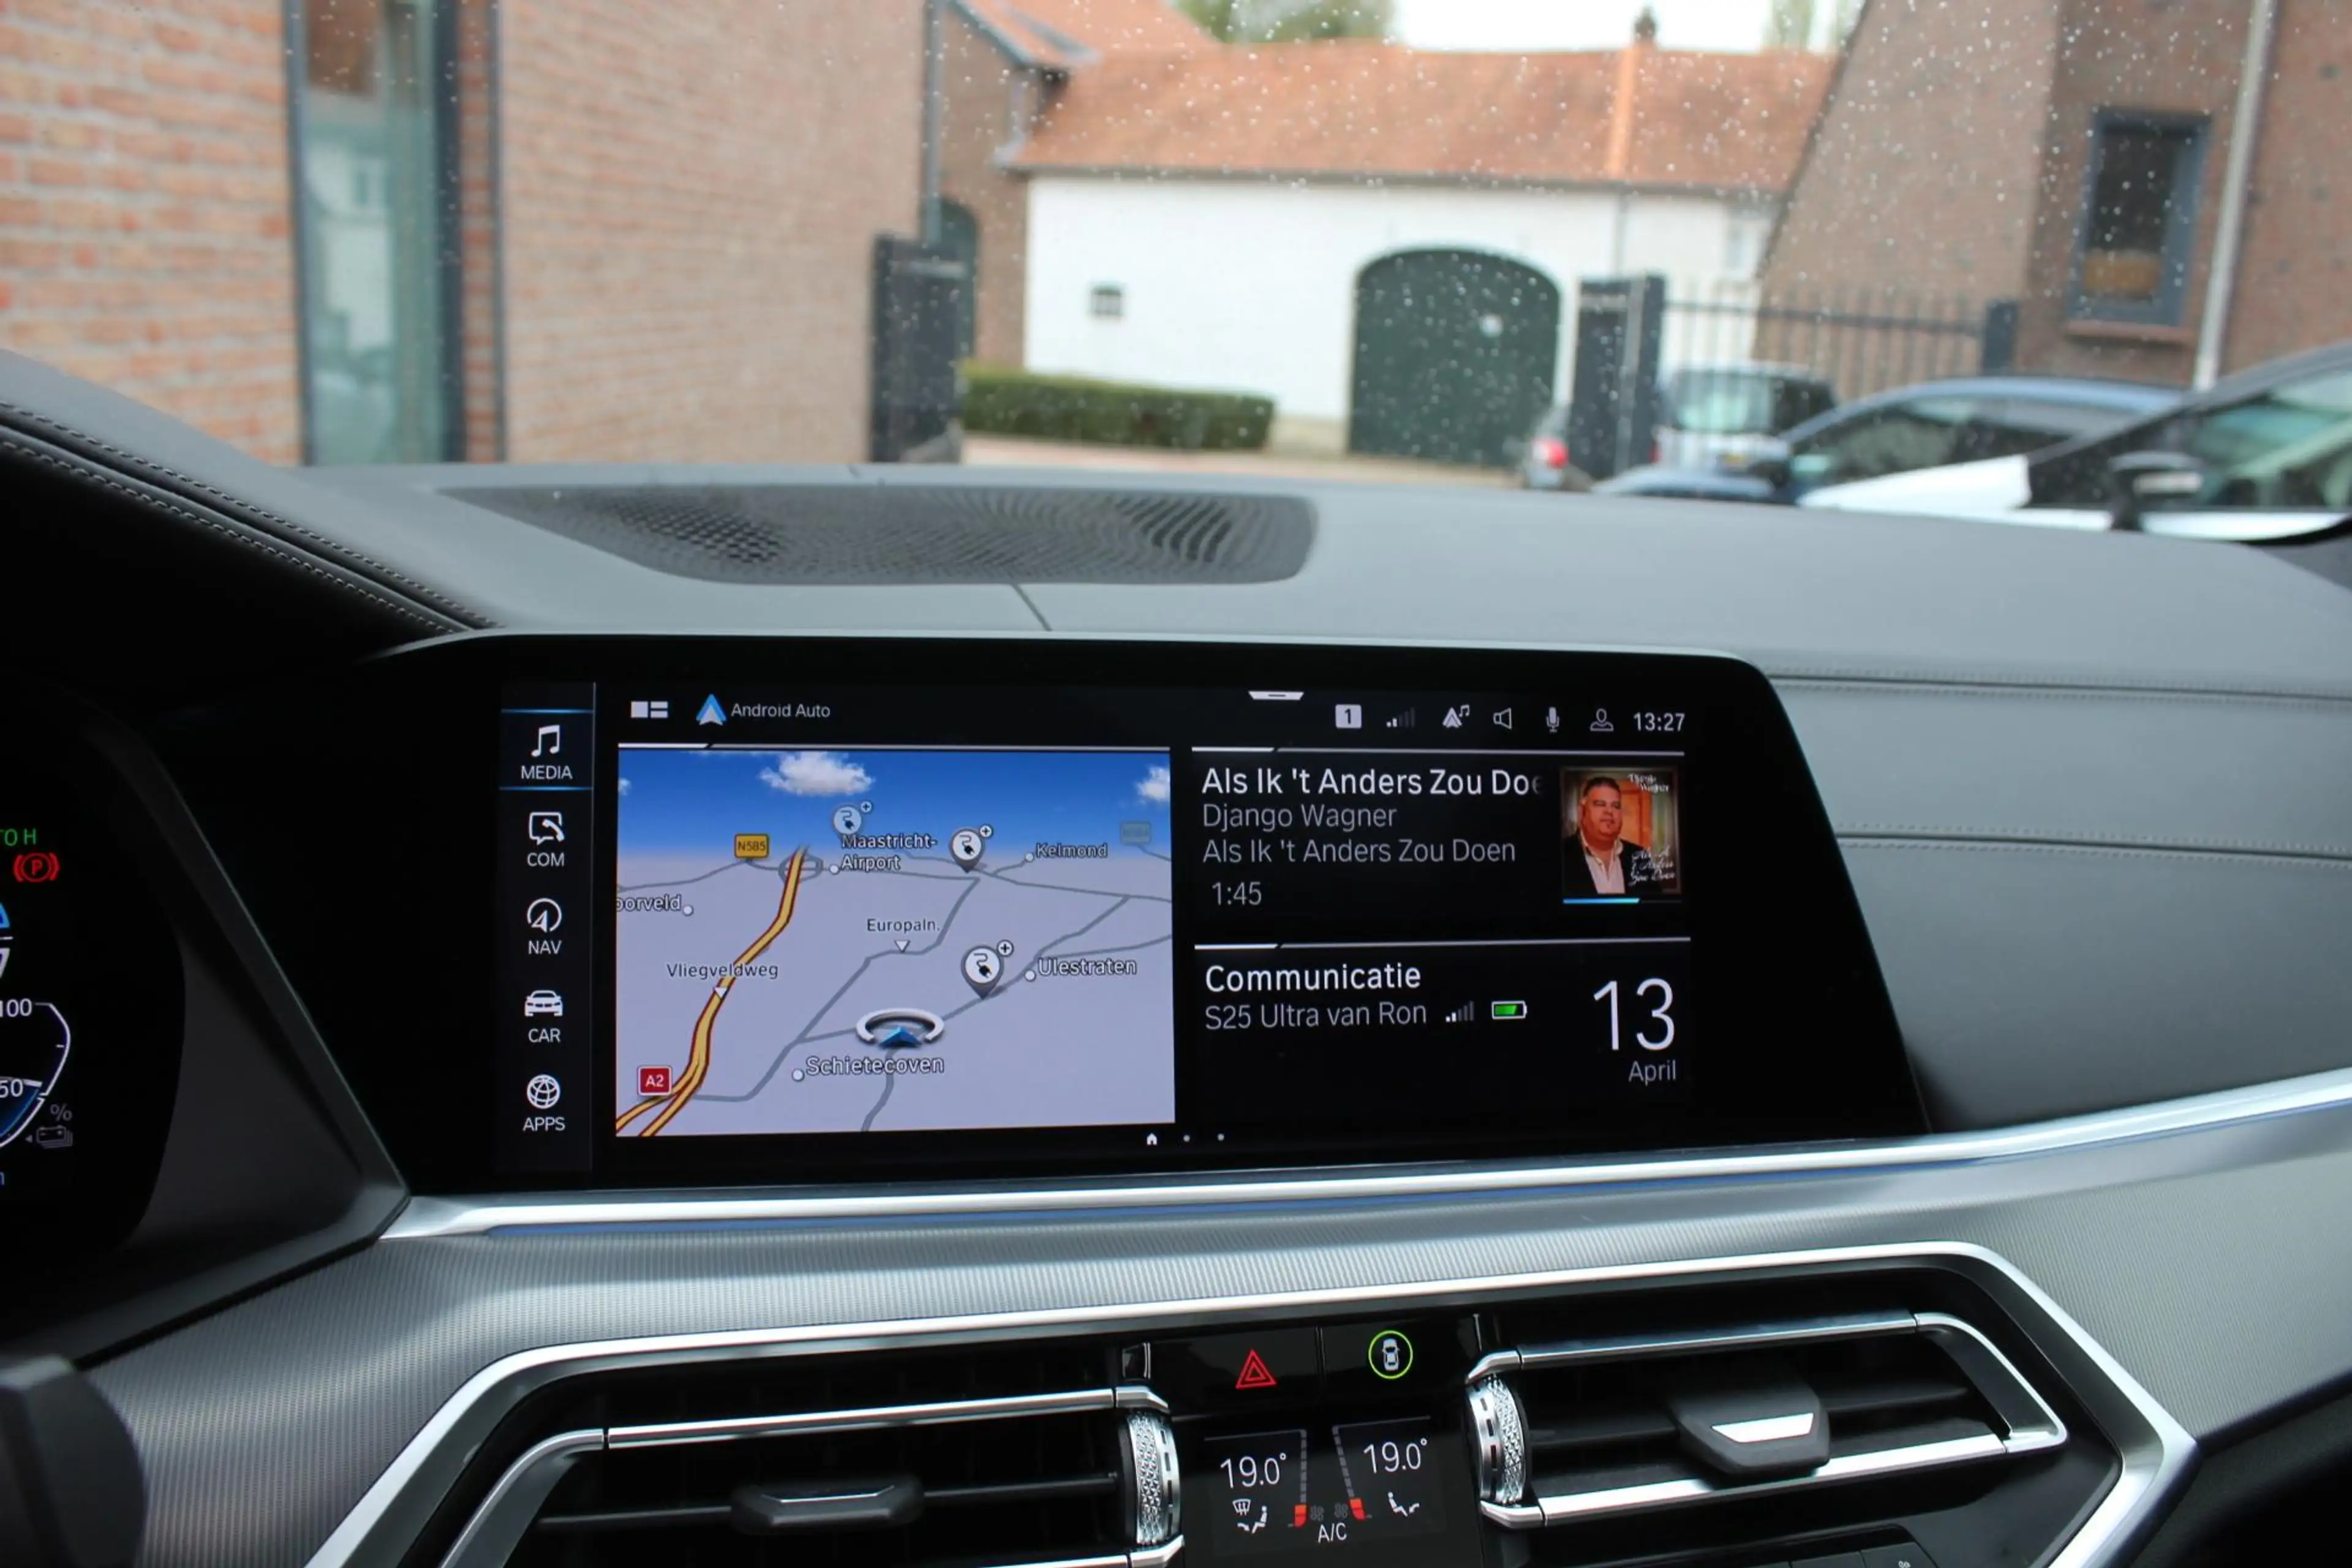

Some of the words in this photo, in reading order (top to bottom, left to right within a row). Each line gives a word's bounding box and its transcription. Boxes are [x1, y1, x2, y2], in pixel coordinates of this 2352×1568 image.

[731, 703, 791, 718] Android
[794, 703, 831, 718] Auto
[1634, 712, 1685, 731] 13:27
[521, 764, 573, 780] MEDIA
[1202, 767, 1248, 794] Als
[1257, 767, 1283, 794] Ik
[1318, 768, 1422, 795] Anders
[1430, 769, 1482, 795] Zou
[1203, 803, 1293, 832] Django
[1300, 804, 1398, 833] Wagner
[527, 852, 565, 867] COM
[1037, 843, 1107, 858] Kelmond
[1202, 839, 1242, 863] Als
[1251, 839, 1272, 863] Ik
[1303, 838, 1392, 862] Anders
[1398, 839, 1444, 862] Zou
[1452, 839, 1515, 862] Doen
[842, 855, 901, 871] Airport
[1212, 881, 1262, 905] 1:45
[528, 940, 562, 955] NAV
[666, 963, 778, 980] Vliegveldweg
[1038, 958, 1137, 976] Ulestraten
[1205, 962, 1421, 992] Communicatie
[1205, 1004, 1251, 1030] S25
[1261, 1003, 1319, 1028] Ultra
[1327, 1006, 1370, 1027] van
[1379, 1001, 1427, 1025] Ron
[1593, 977, 1675, 1051] 13
[527, 1027, 561, 1043] CAR
[805, 1055, 945, 1076] Schietecoven
[1628, 1059, 1676, 1087] April
[646, 1074, 665, 1088] A2
[522, 1116, 566, 1132] APPS
[1317, 1521, 1348, 1544] A/C
